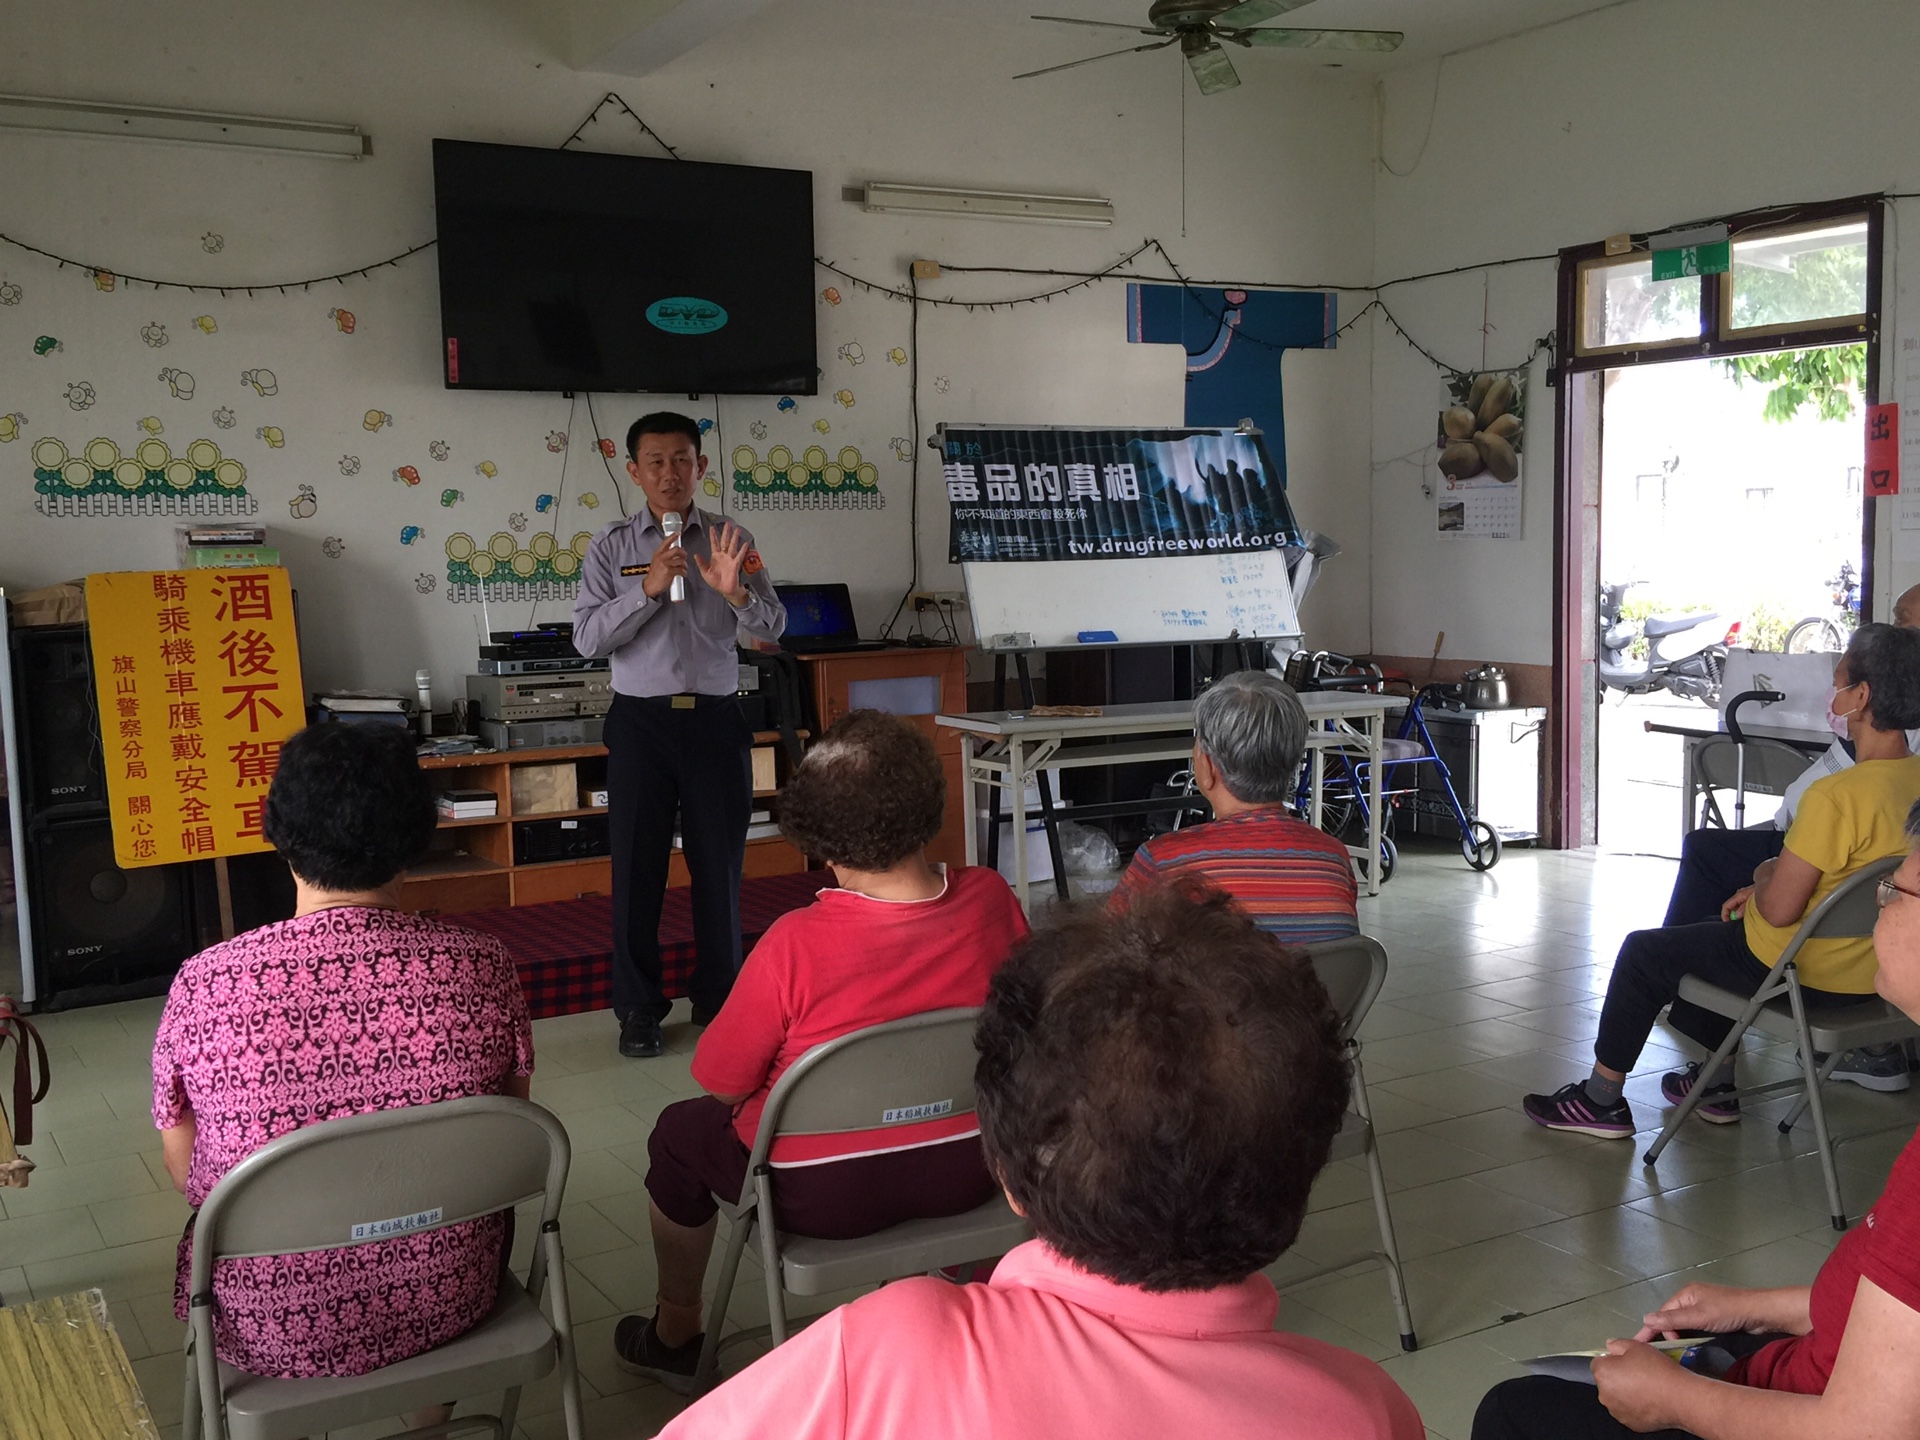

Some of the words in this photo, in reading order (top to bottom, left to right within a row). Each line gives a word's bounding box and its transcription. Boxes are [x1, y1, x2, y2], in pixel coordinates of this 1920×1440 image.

[1660, 271, 1677, 280] EXIT
[658, 303, 721, 320] DVD
[1870, 412, 1890, 489] 出口
[943, 462, 1141, 502] 毒品的真相
[1446, 473, 1457, 491] 3
[1068, 531, 1287, 556] tw.drugfreeworld.org
[112, 655, 148, 780] 旗山警察分局
[153, 574, 216, 855] 騎乘機車應戴安全帽
[51, 785, 87, 795] SONY
[128, 795, 157, 858] 關心您
[67, 944, 103, 956] SONY
[355, 1210, 440, 1237] 日本稻城扶輪社
